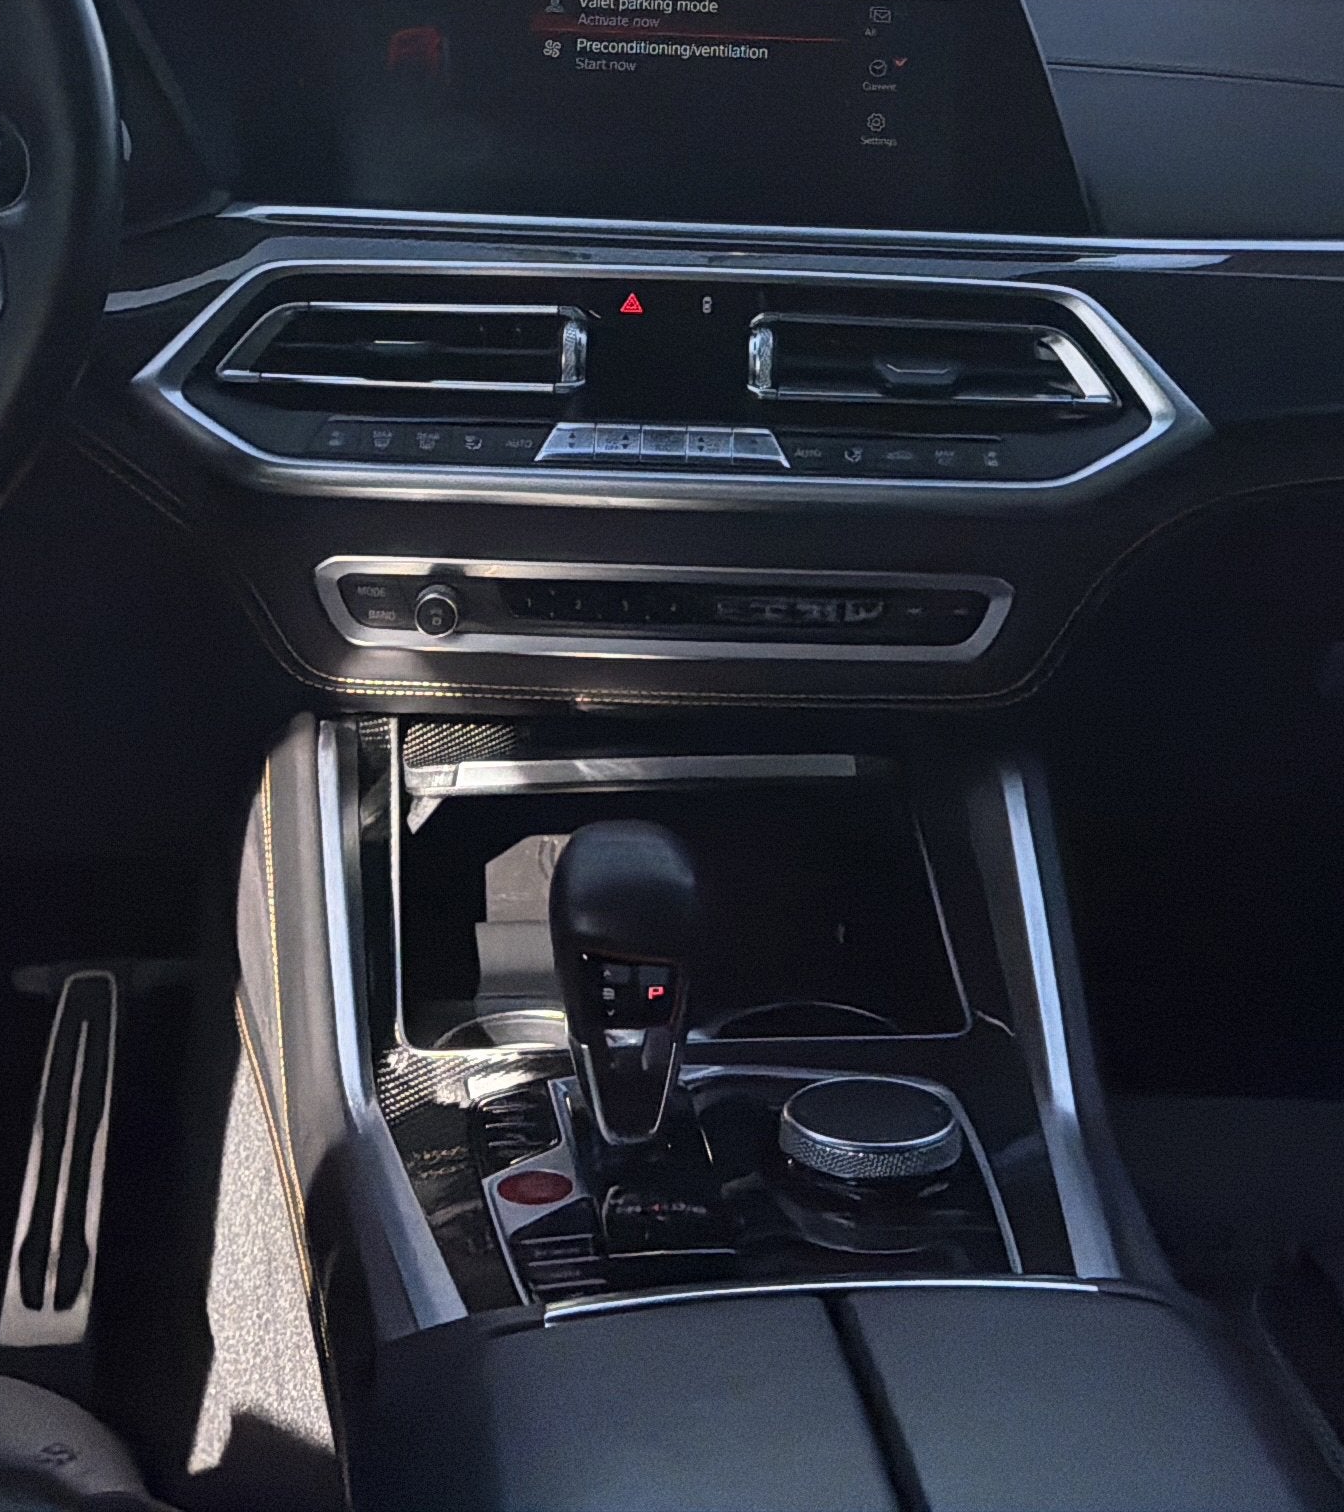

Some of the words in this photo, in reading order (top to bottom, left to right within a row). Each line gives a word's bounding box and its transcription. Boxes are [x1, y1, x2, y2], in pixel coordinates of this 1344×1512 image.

[676, 0, 719, 13] mode
[577, 13, 630, 27] Activate
[632, 17, 660, 28] now
[576, 38, 769, 60] Preconditioning/ventilation
[575, 57, 609, 70] Start
[609, 61, 637, 72] now
[647, 986, 665, 1000] P
